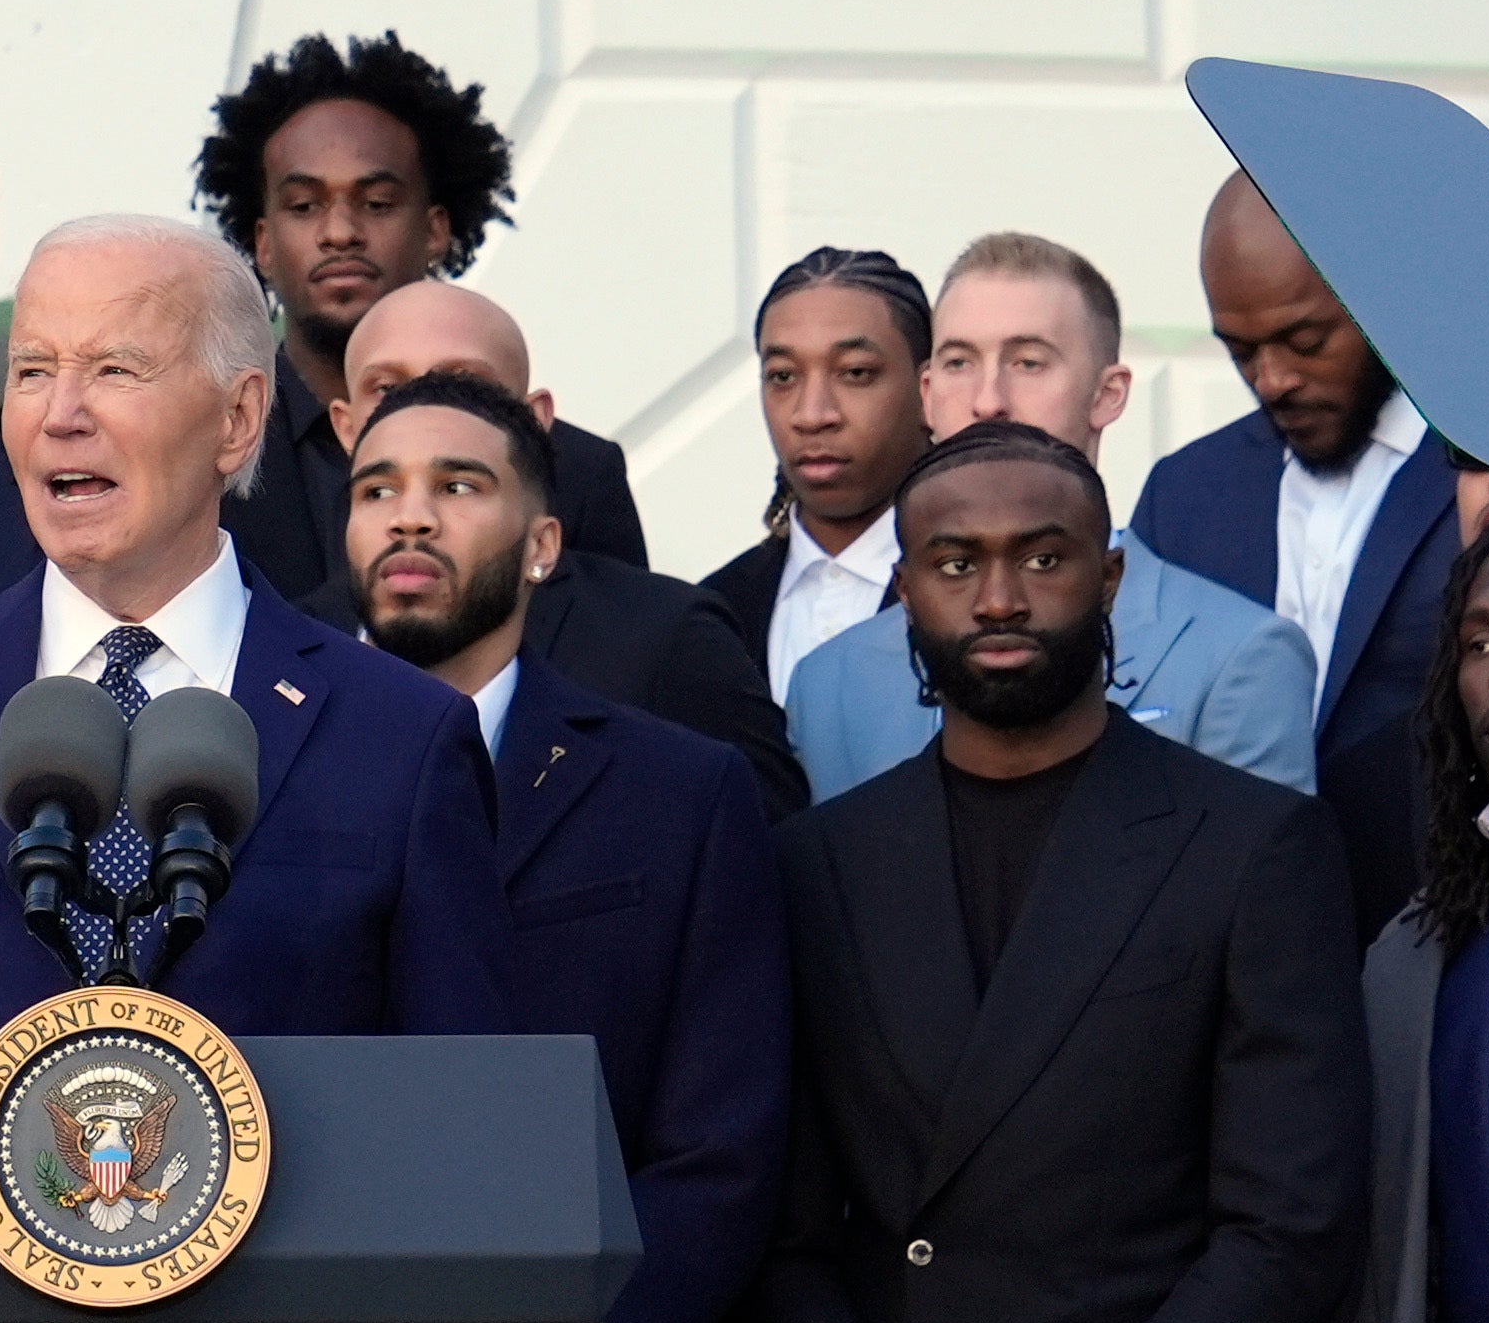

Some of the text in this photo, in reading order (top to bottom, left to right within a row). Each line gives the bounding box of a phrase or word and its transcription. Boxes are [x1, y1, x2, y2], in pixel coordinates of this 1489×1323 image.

[110, 1002, 139, 1021] OF
[145, 1007, 185, 1038] THE
[193, 1033, 260, 1162] UNITED
[3, 1227, 85, 1291] SEAL
[141, 1193, 248, 1291] STATES
